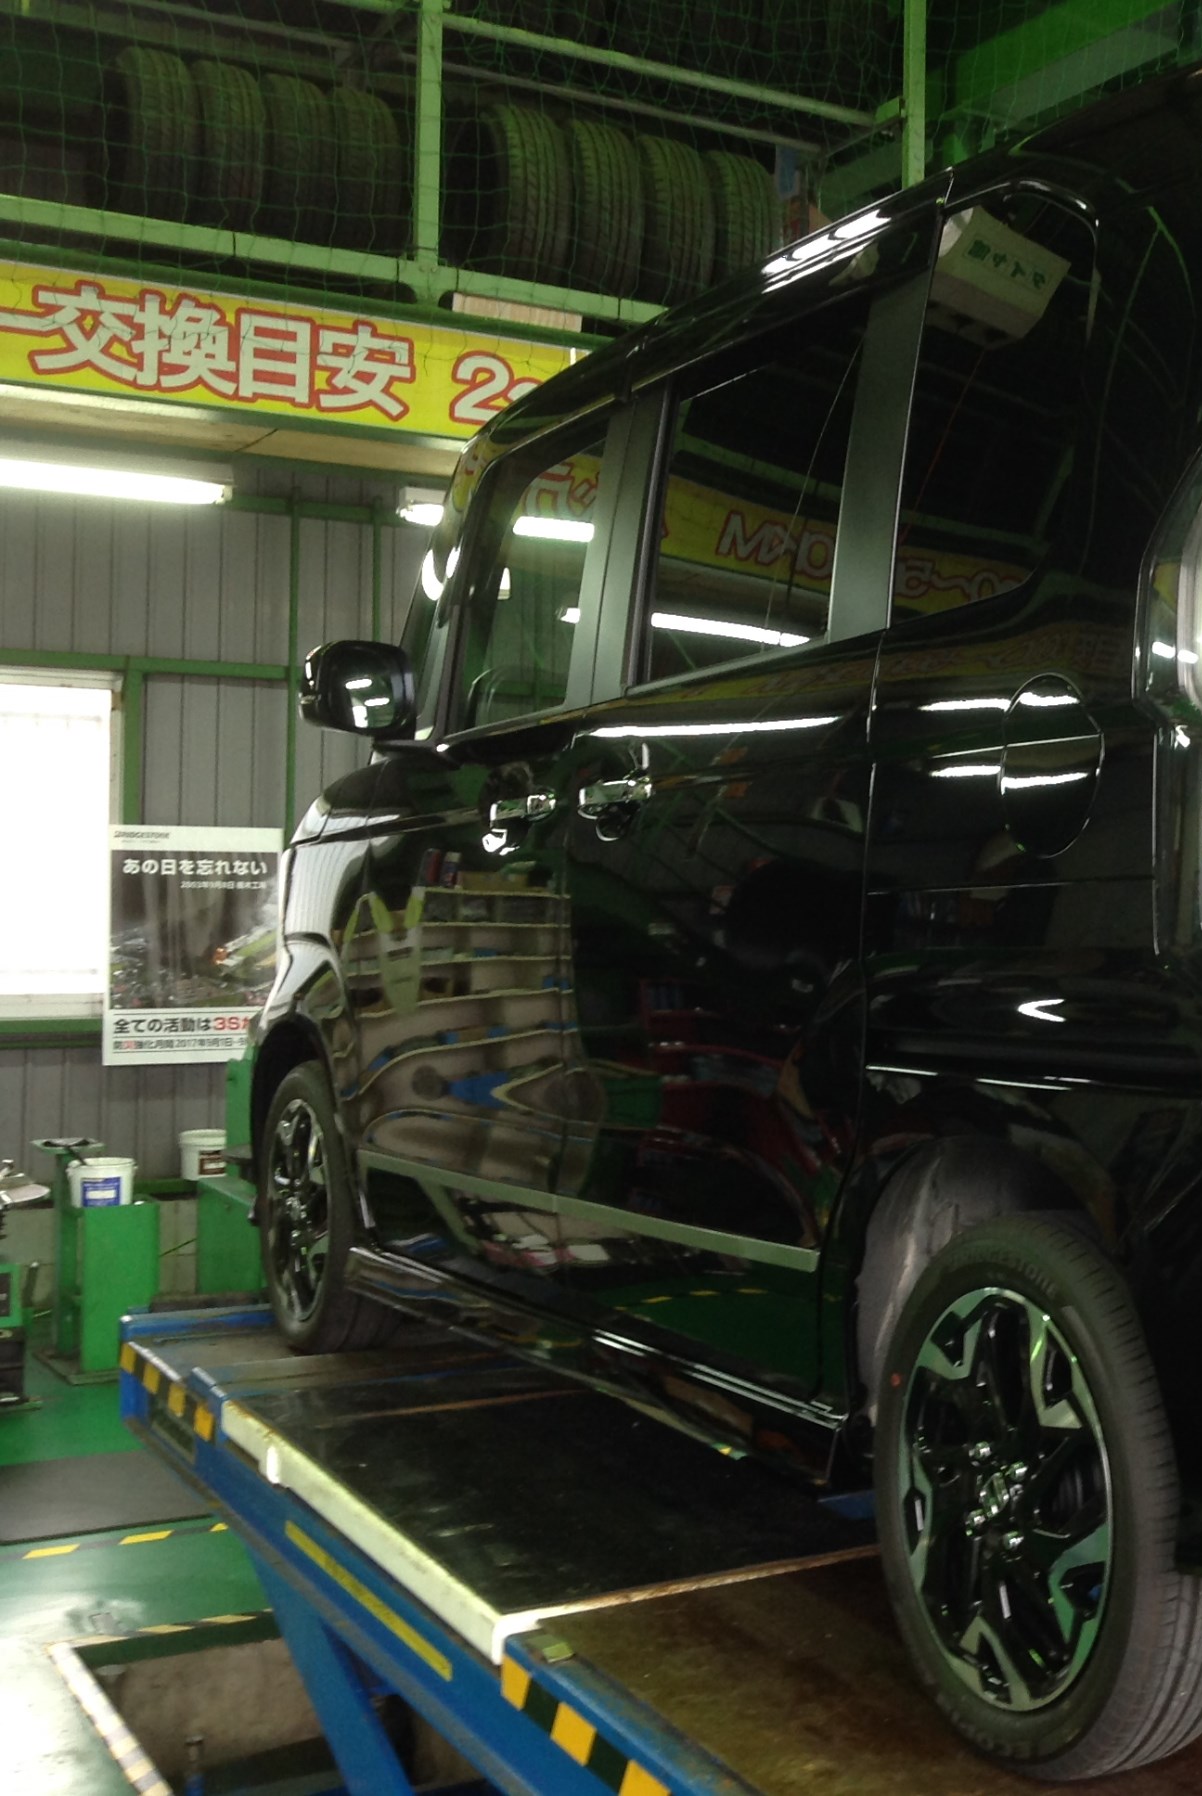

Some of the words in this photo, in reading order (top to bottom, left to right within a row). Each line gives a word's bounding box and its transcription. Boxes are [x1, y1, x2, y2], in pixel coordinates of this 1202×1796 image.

[449, 350, 543, 425] 2
[122, 858, 268, 875] あの日を忘れない
